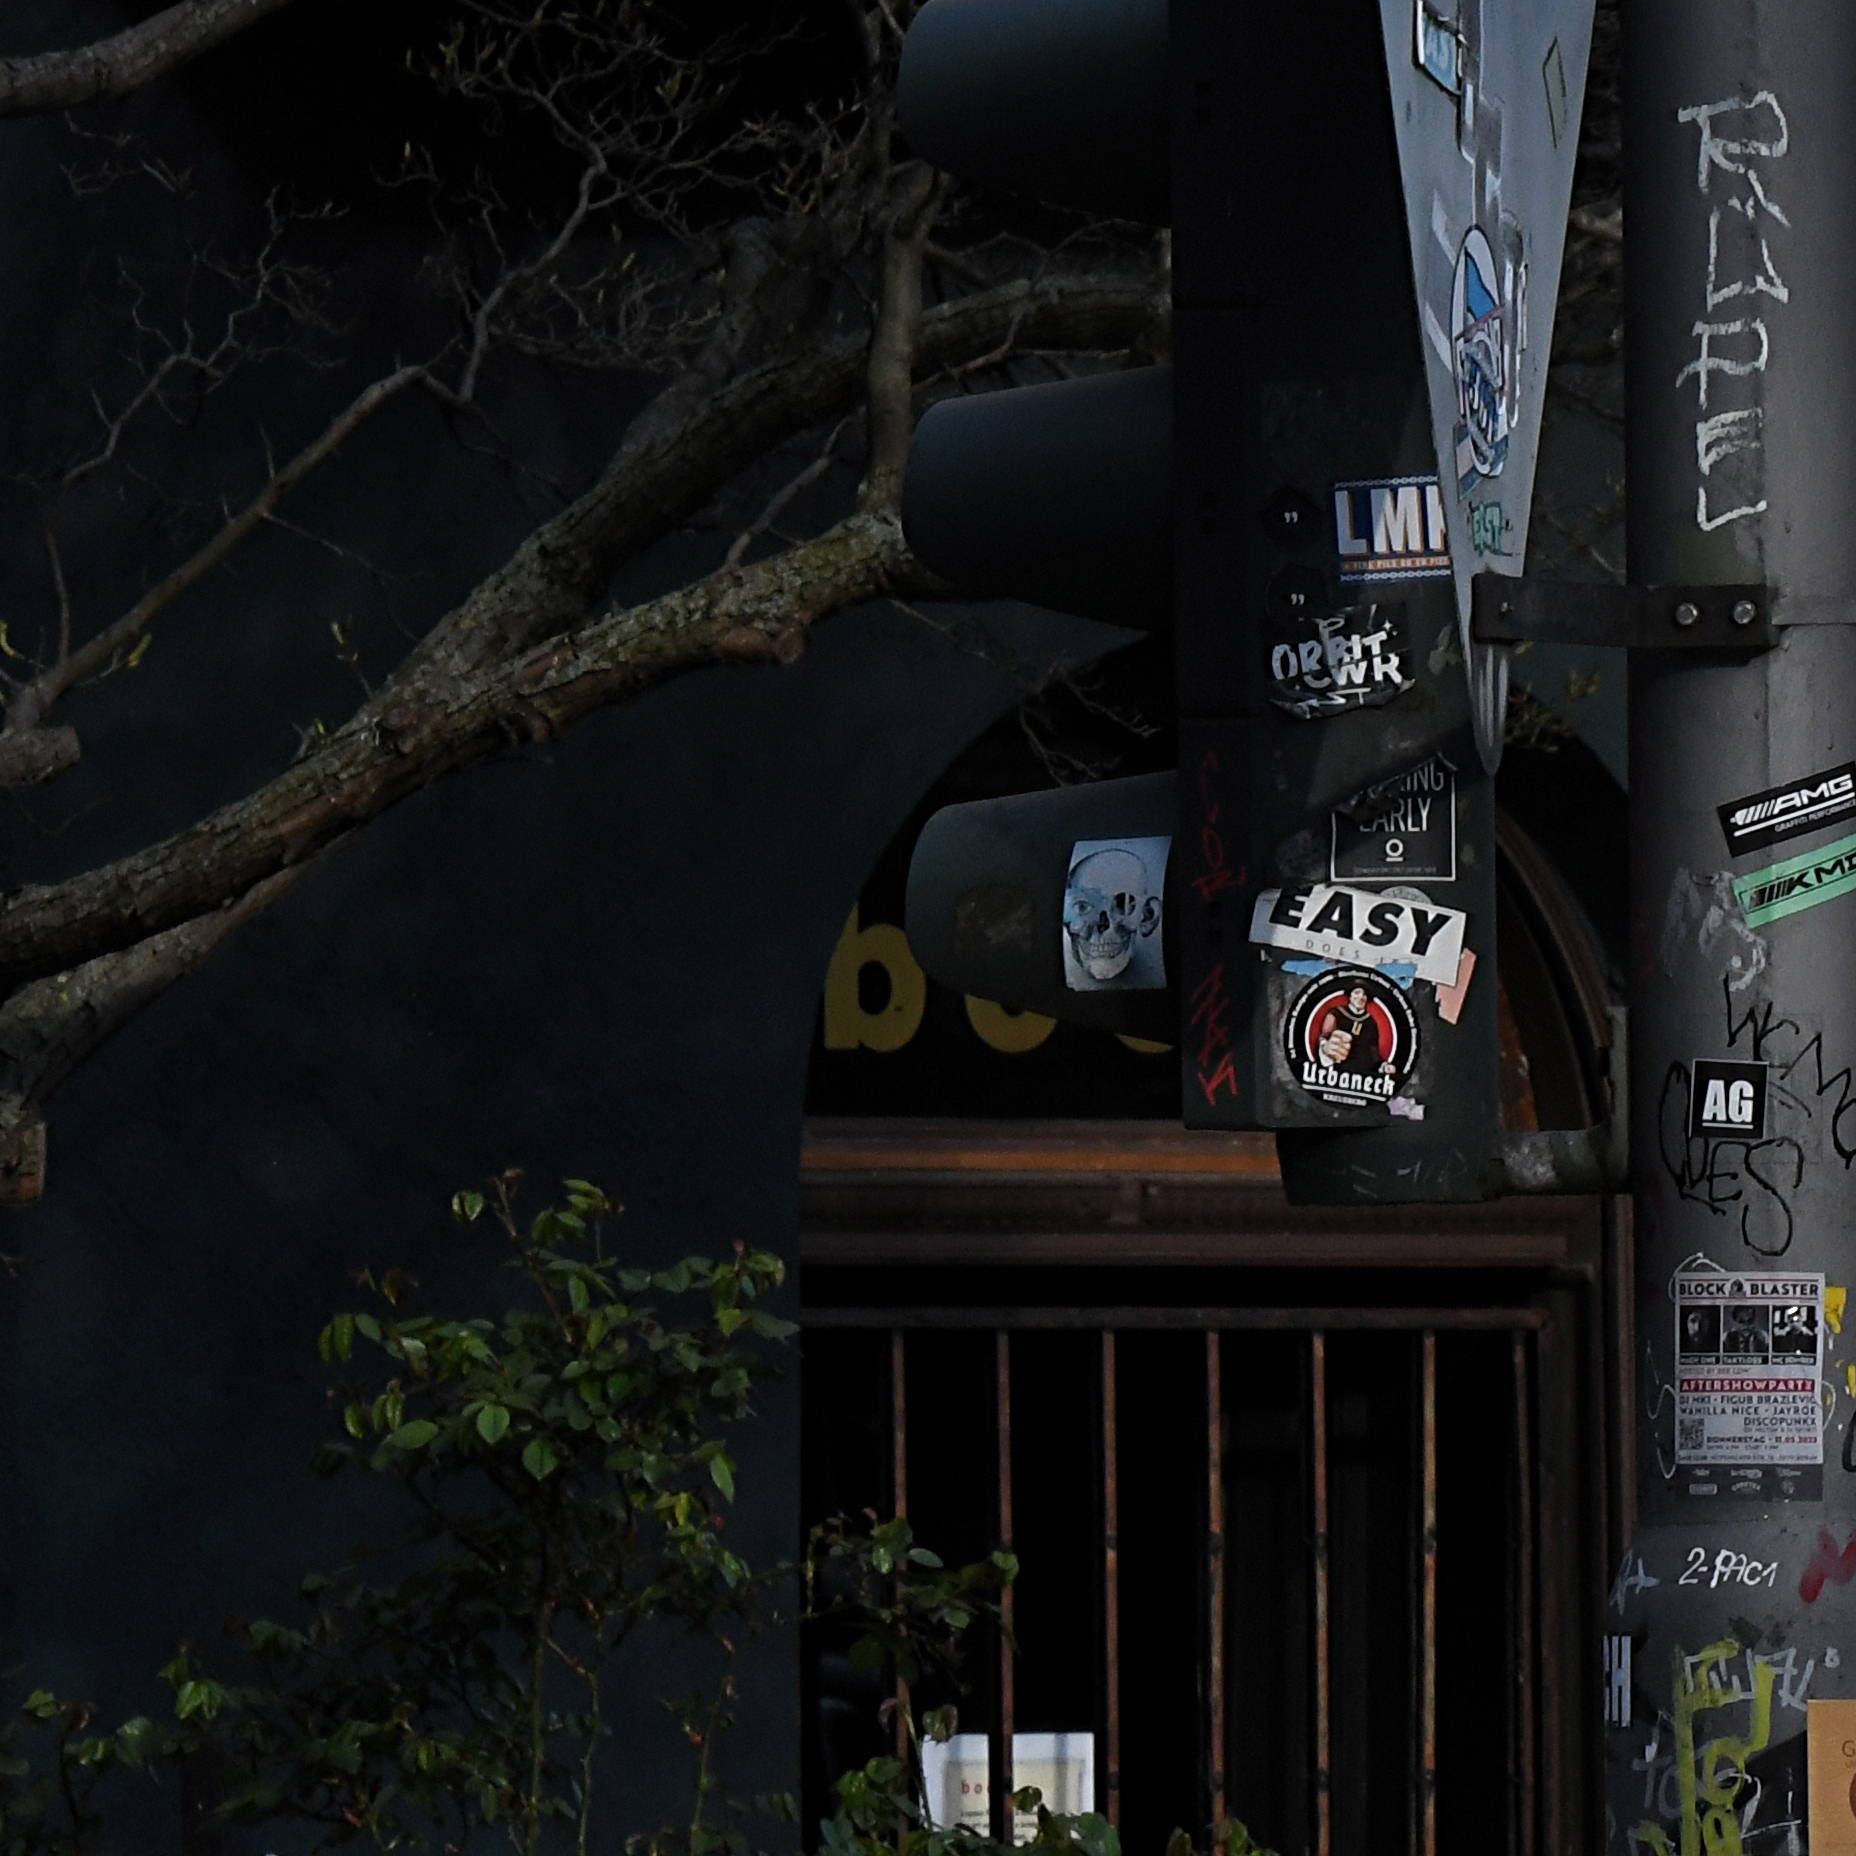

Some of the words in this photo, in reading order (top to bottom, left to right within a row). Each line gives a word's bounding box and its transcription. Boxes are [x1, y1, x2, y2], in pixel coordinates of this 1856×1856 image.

[1360, 797, 1431, 832] ARLY
[1269, 888, 1451, 956] EASY
[1302, 1061, 1397, 1096] Urbaneck
[1703, 1079, 1754, 1123] AG
[1680, 1283, 1726, 1296] BLOCK
[1750, 1283, 1818, 1296] BLASTER
